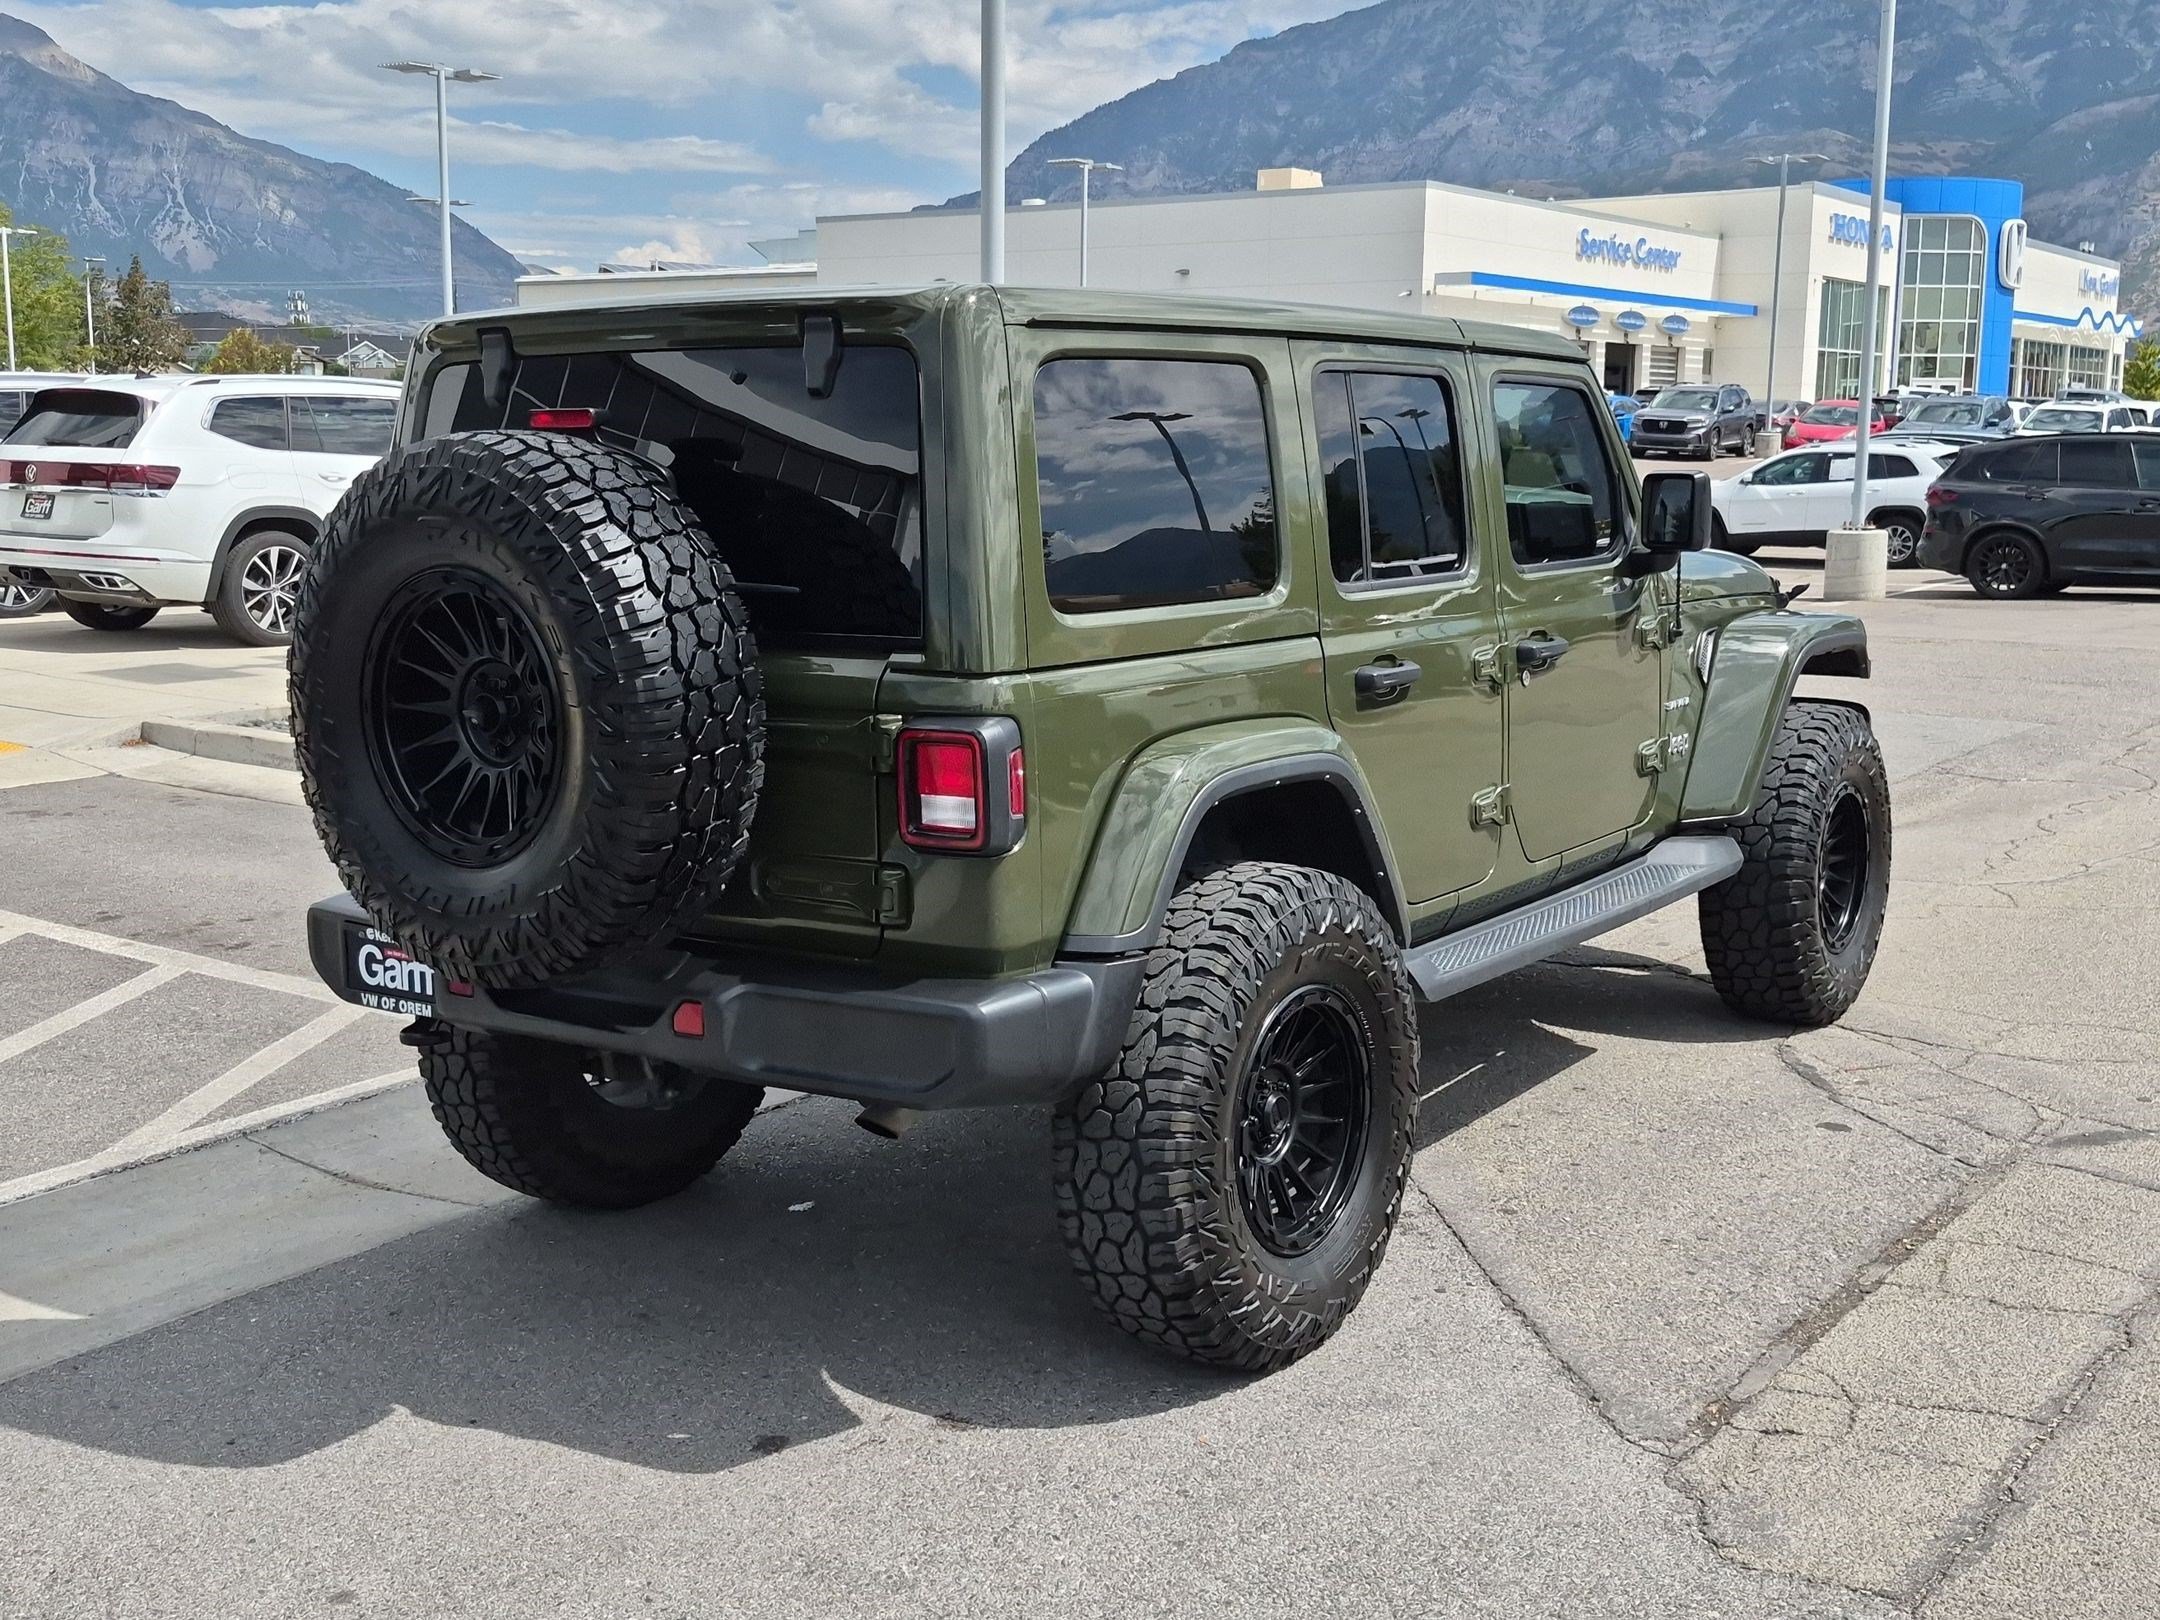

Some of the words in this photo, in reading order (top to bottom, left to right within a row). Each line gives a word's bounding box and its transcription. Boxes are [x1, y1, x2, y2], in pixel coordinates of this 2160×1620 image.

[1833, 213, 1893, 249] HONA
[1580, 228, 1631, 261] Service
[1635, 238, 1681, 269] Center
[25, 498, 52, 514] Garff
[360, 992, 378, 1008] VW
[381, 996, 396, 1011] OF
[399, 999, 432, 1018] OREM
